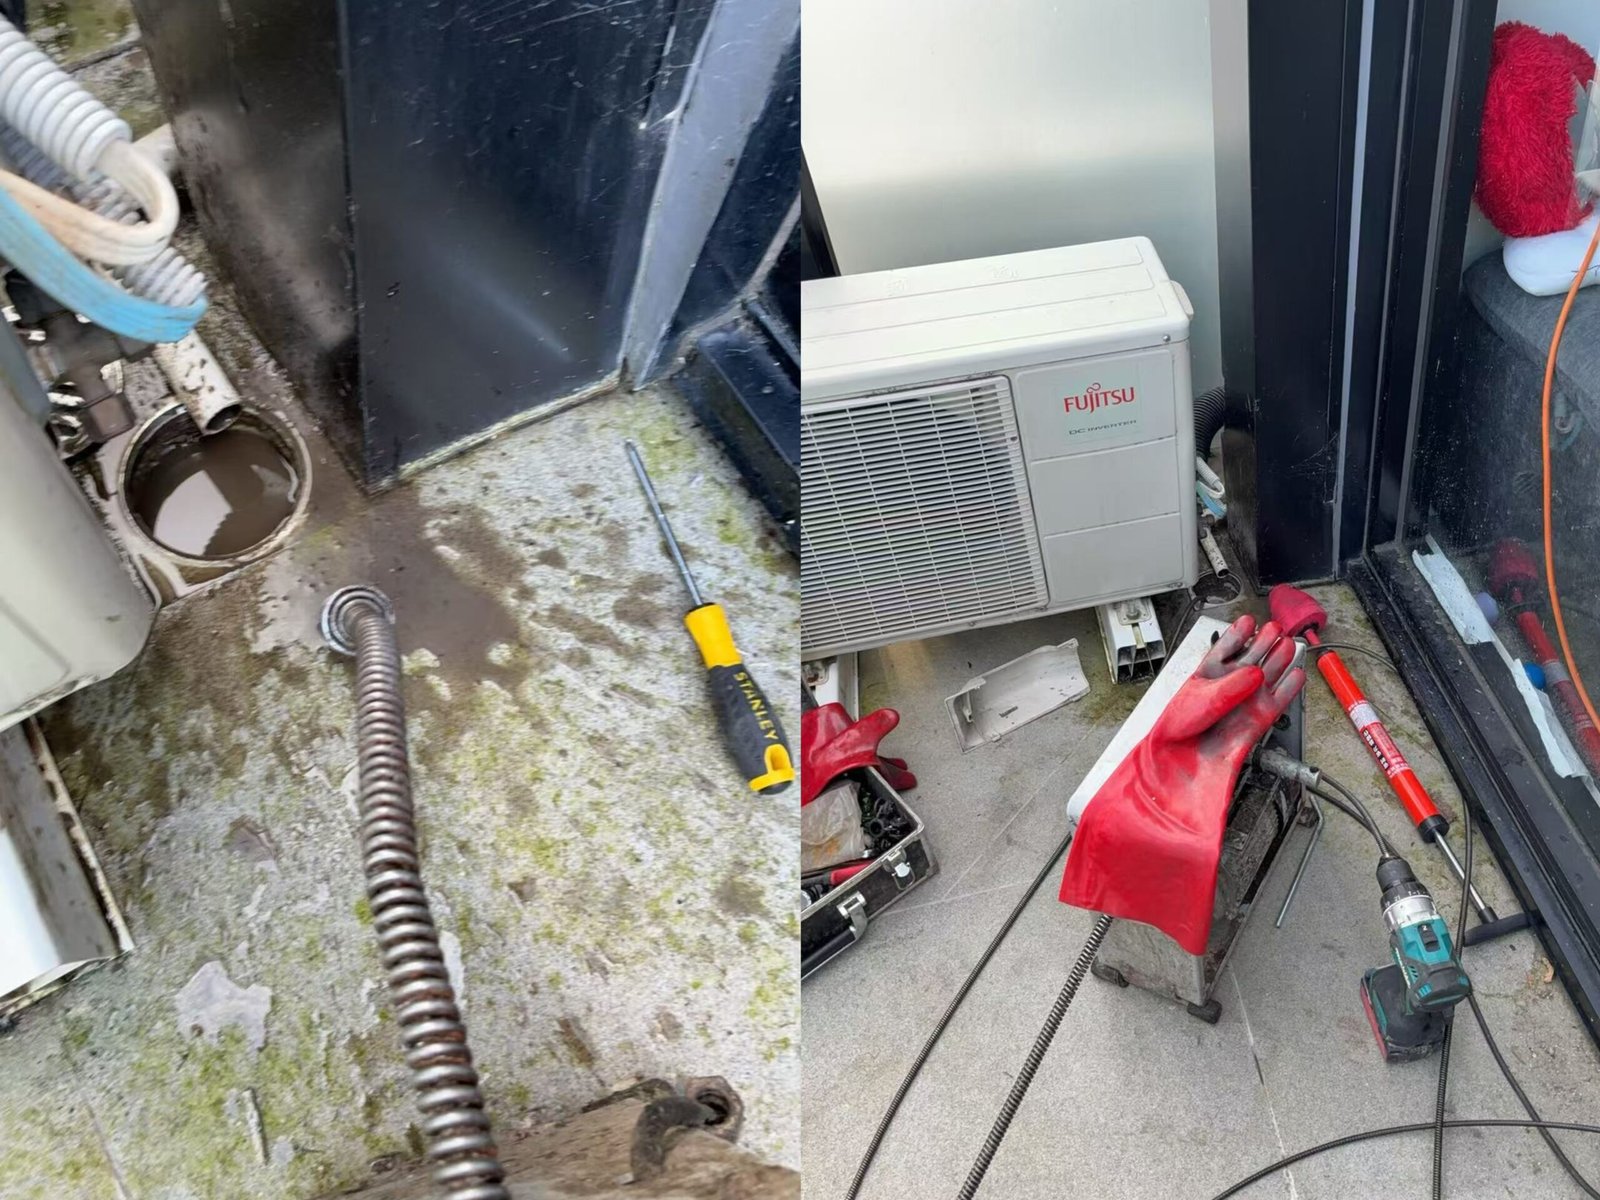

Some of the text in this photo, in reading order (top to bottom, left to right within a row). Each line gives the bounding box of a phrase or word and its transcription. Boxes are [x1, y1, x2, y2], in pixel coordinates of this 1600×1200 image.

[1063, 384, 1135, 413] FUJITSU
[1087, 419, 1137, 431] INVERTER
[734, 671, 779, 739] STANLEY
